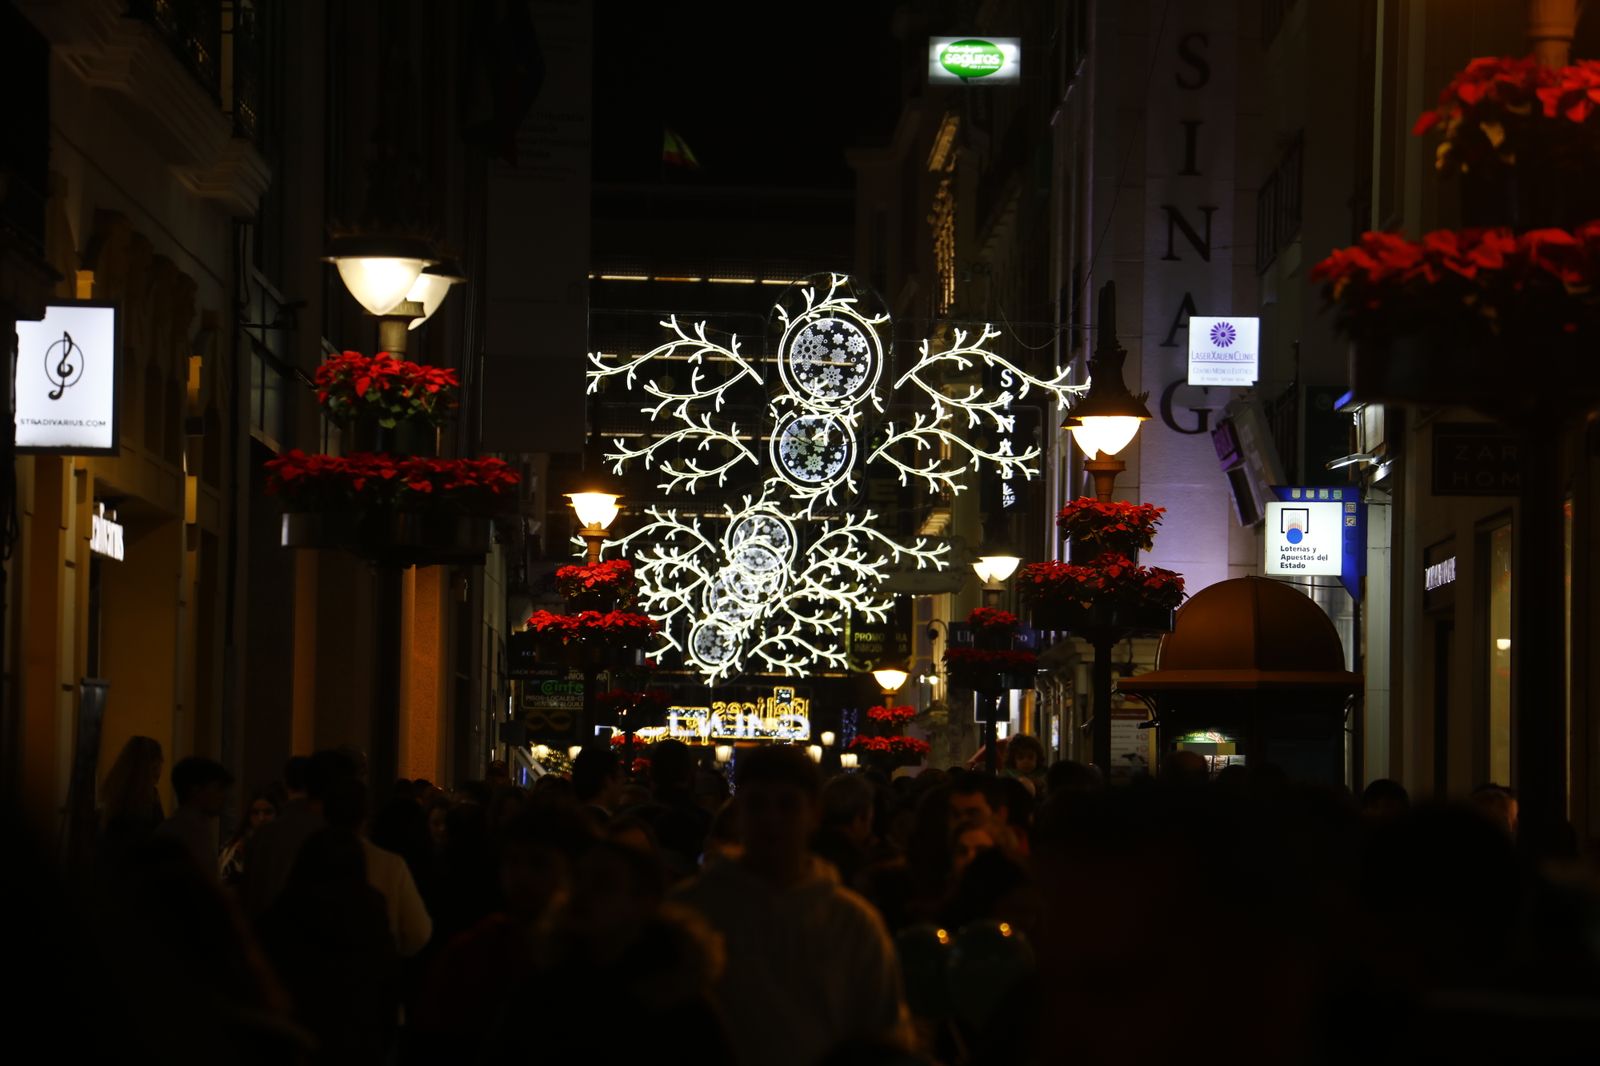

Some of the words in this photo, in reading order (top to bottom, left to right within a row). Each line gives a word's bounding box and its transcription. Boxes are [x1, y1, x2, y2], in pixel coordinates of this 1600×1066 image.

[944, 53, 1000, 68] seguros
[1455, 444, 1519, 461] ZAR
[1452, 472, 1520, 489] HOM
[1280, 553, 1315, 562] Apuestas
